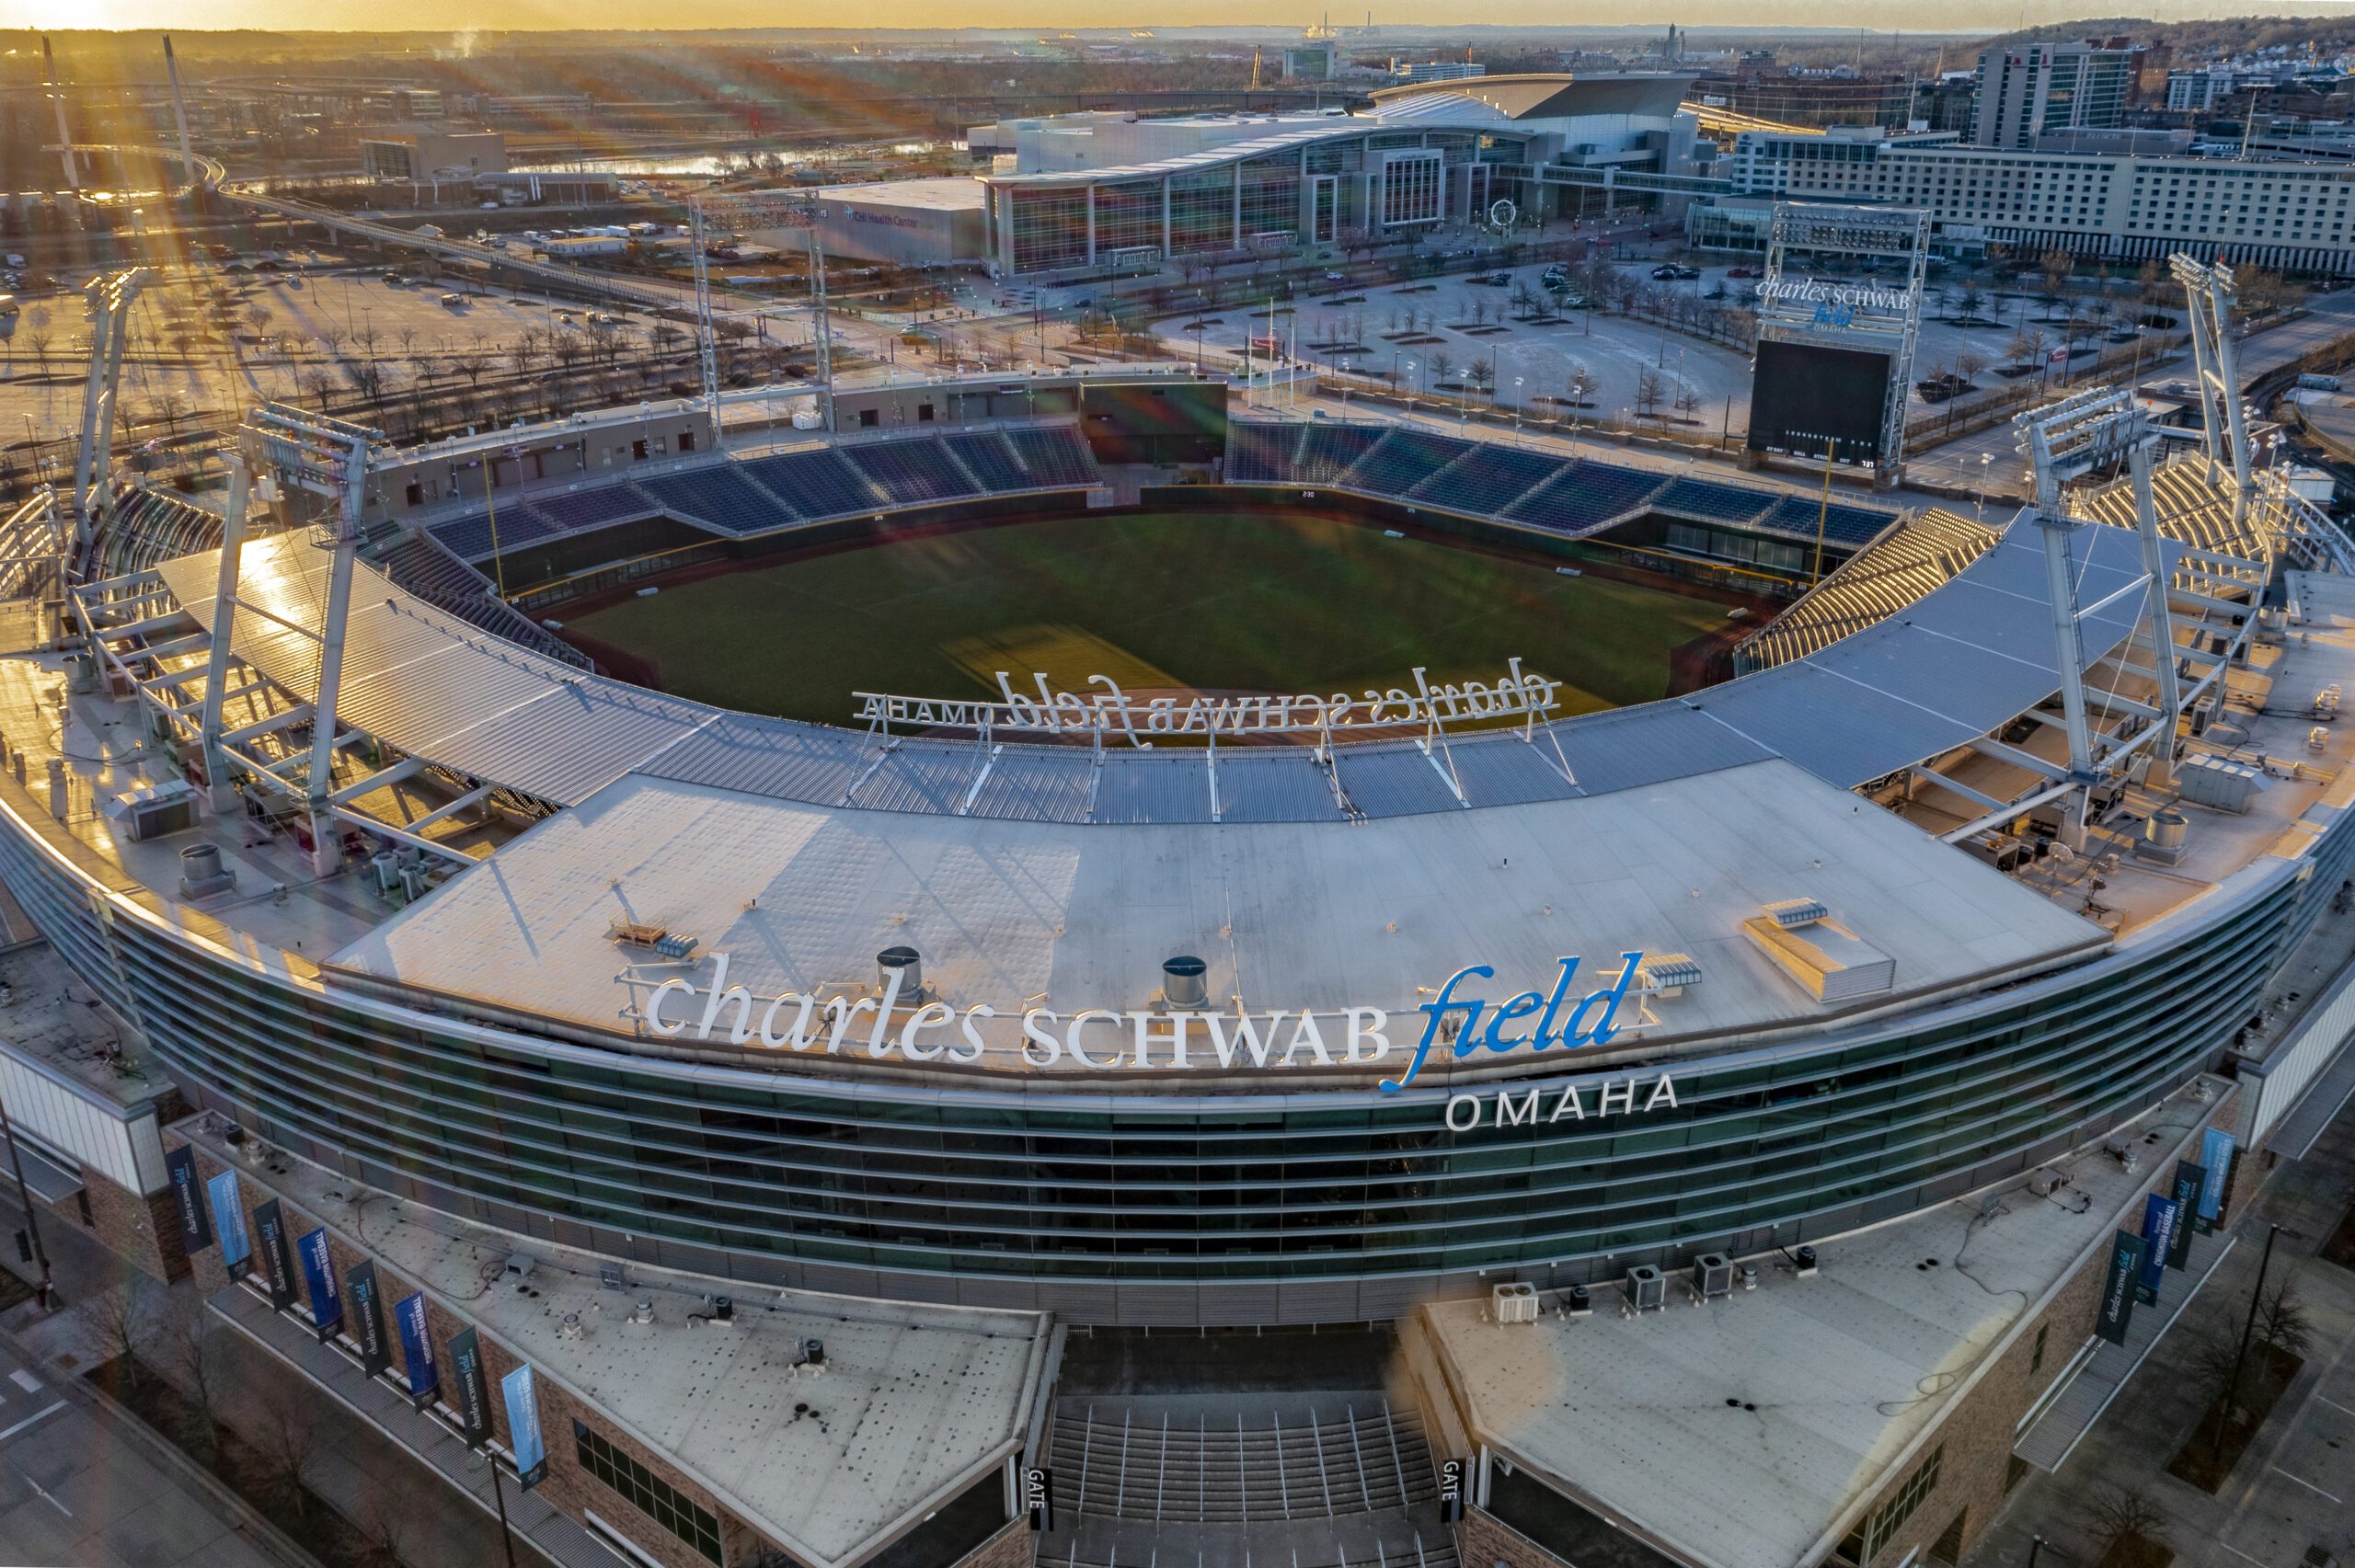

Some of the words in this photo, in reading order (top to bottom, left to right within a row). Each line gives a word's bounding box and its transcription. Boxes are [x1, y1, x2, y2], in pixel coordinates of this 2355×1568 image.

[855, 212, 867, 223] CHI
[868, 212, 893, 225] Health
[893, 215, 918, 228] Center
[1755, 274, 1831, 303] charles
[1832, 288, 1910, 310] SCHWAB
[1806, 301, 1855, 329] field
[1813, 324, 1847, 335] OMAHA
[647, 952, 995, 1062] charles
[1022, 1007, 1391, 1069] SCHWAB
[1378, 951, 1643, 1093] field
[1445, 1074, 1678, 1132] OMAHA
[2161, 1205, 2176, 1234] BASEBALL
[316, 1231, 329, 1264] BASEBALL
[413, 1297, 425, 1329] BASEBALL
[2107, 1295, 2120, 1322] charles
[366, 1331, 378, 1355] charles
[469, 1402, 482, 1429] charles
[1028, 1470, 1045, 1509] GATE
[1442, 1461, 1459, 1501] GATE
